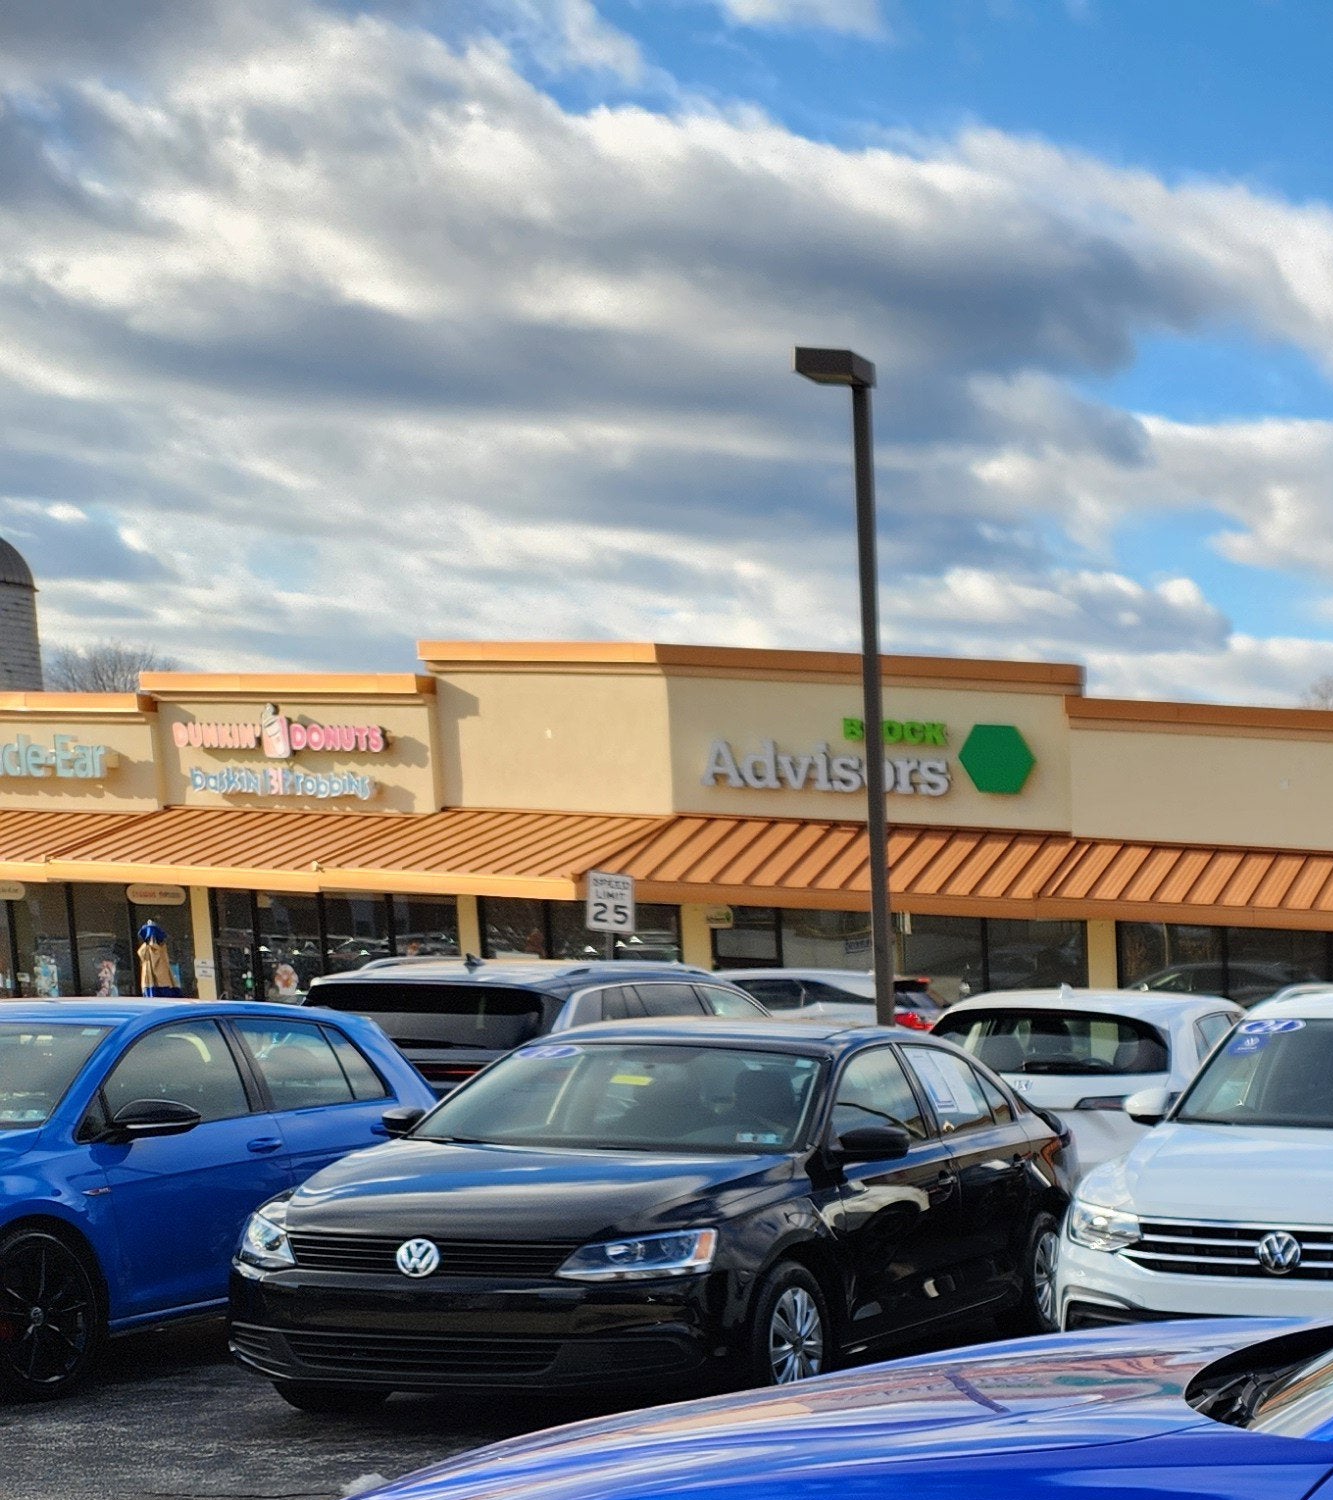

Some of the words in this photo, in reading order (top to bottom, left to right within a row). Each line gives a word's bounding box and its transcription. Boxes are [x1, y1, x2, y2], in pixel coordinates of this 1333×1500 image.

[172, 722, 261, 749] DUNKIN'
[290, 723, 384, 752] DONUTS
[843, 718, 947, 746] BOCK
[0, 733, 106, 778] cle-Ear
[593, 902, 629, 925] 25
